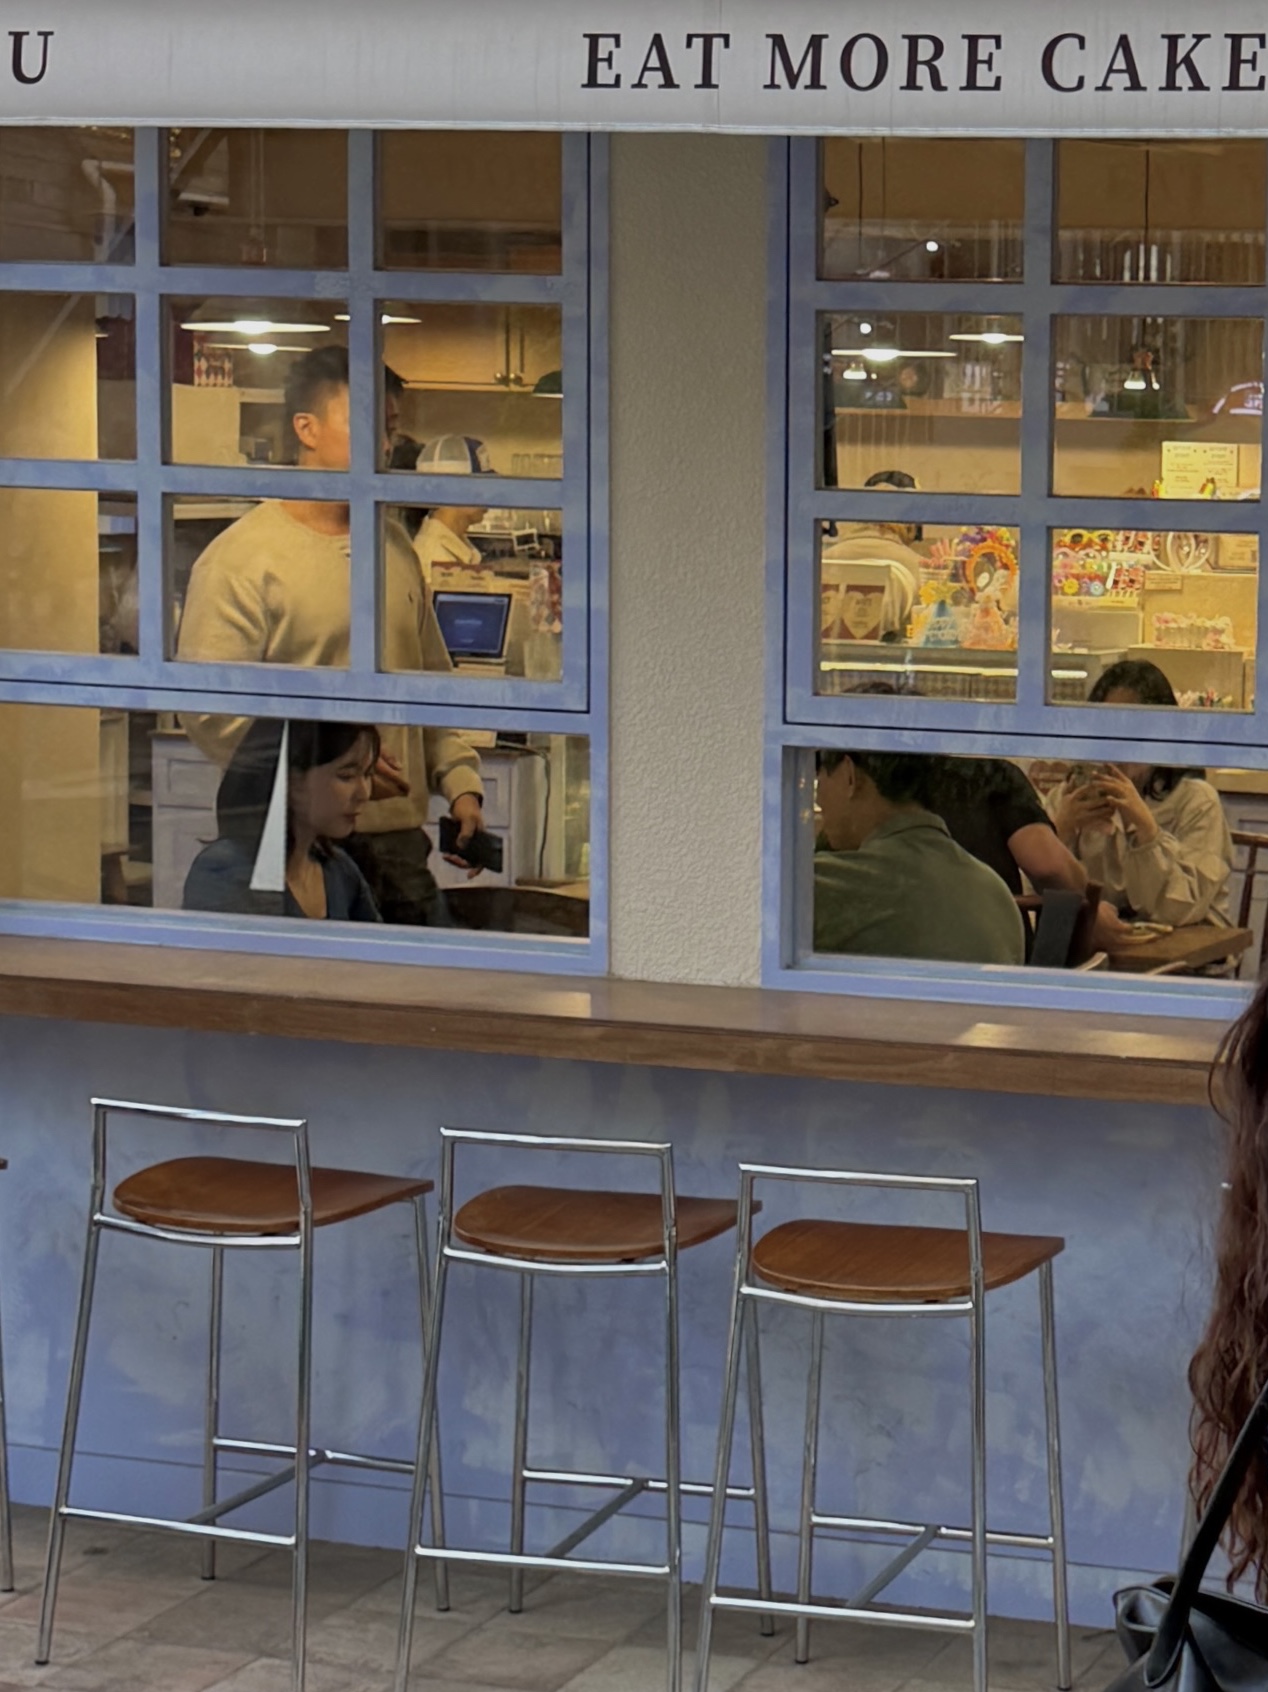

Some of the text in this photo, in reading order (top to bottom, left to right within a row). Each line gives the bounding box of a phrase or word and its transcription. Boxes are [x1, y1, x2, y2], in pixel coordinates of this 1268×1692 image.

[8, 31, 54, 85] U
[581, 32, 1268, 92] EAT MORE CAKE
